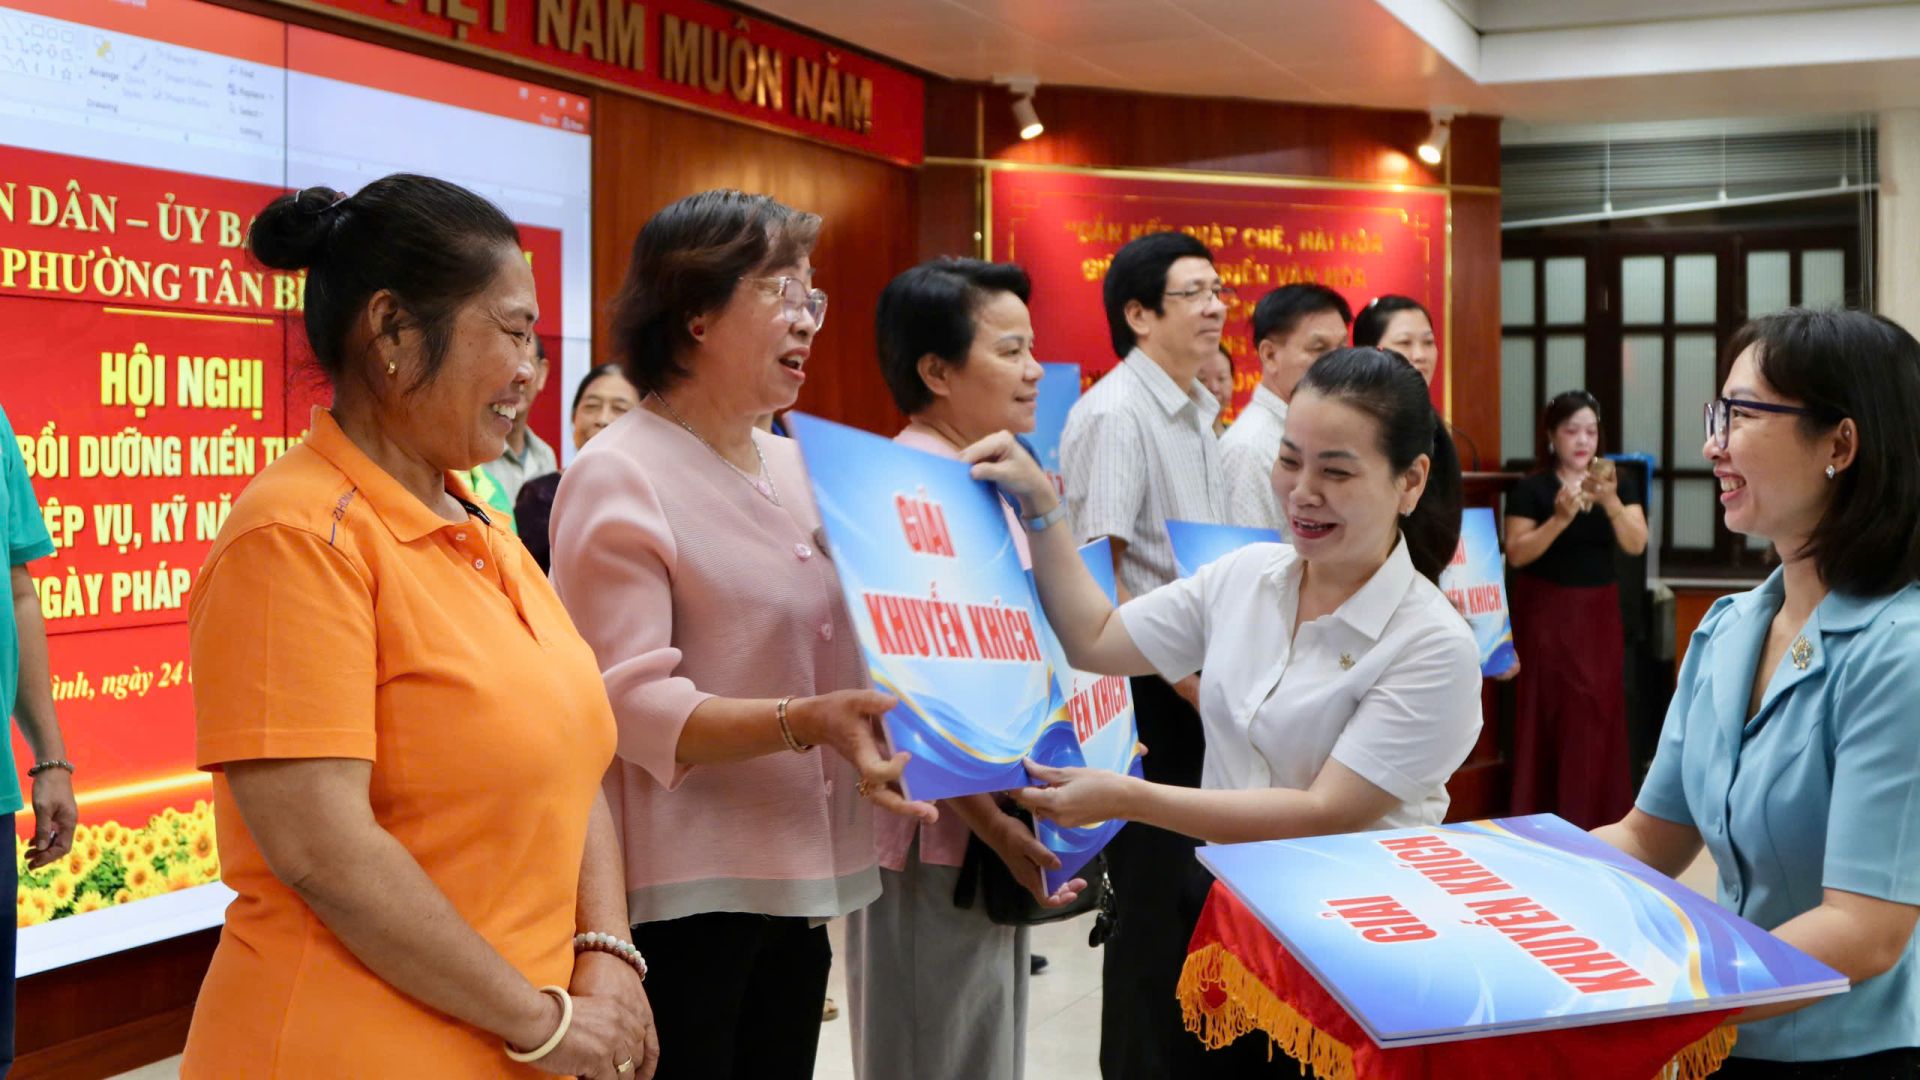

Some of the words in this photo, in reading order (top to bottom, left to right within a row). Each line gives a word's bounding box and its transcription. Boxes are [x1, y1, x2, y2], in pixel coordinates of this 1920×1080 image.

[537, 0, 646, 71] NAM
[663, 13, 783, 110] MUÔN
[796, 51, 873, 134] NĂM
[28, 179, 117, 233] DÂN
[157, 192, 209, 244] ỦY
[1, 246, 182, 301] PHƯỜNG
[189, 258, 264, 308] TÂN
[273, 267, 306, 312] BÌ
[101, 342, 166, 418] HỘI
[178, 356, 263, 420] NGHỊ
[16, 421, 69, 478] BỒI
[79, 427, 181, 477] DƯỠNG
[190, 424, 255, 476] KIẾN
[93, 503, 142, 554] VỤ,
[152, 494, 188, 543] KỸ
[111, 561, 191, 614] PHÁP
[864, 581, 973, 658] KHUYẾN
[967, 599, 1042, 661] KHÍCH
[52, 674, 95, 701] ình,
[101, 665, 154, 700] ngày
[157, 660, 184, 688] 24
[1378, 835, 1514, 895] KHÍCH
[1321, 895, 1438, 943] GIẢI
[1460, 896, 1656, 994] KHUYẾN
